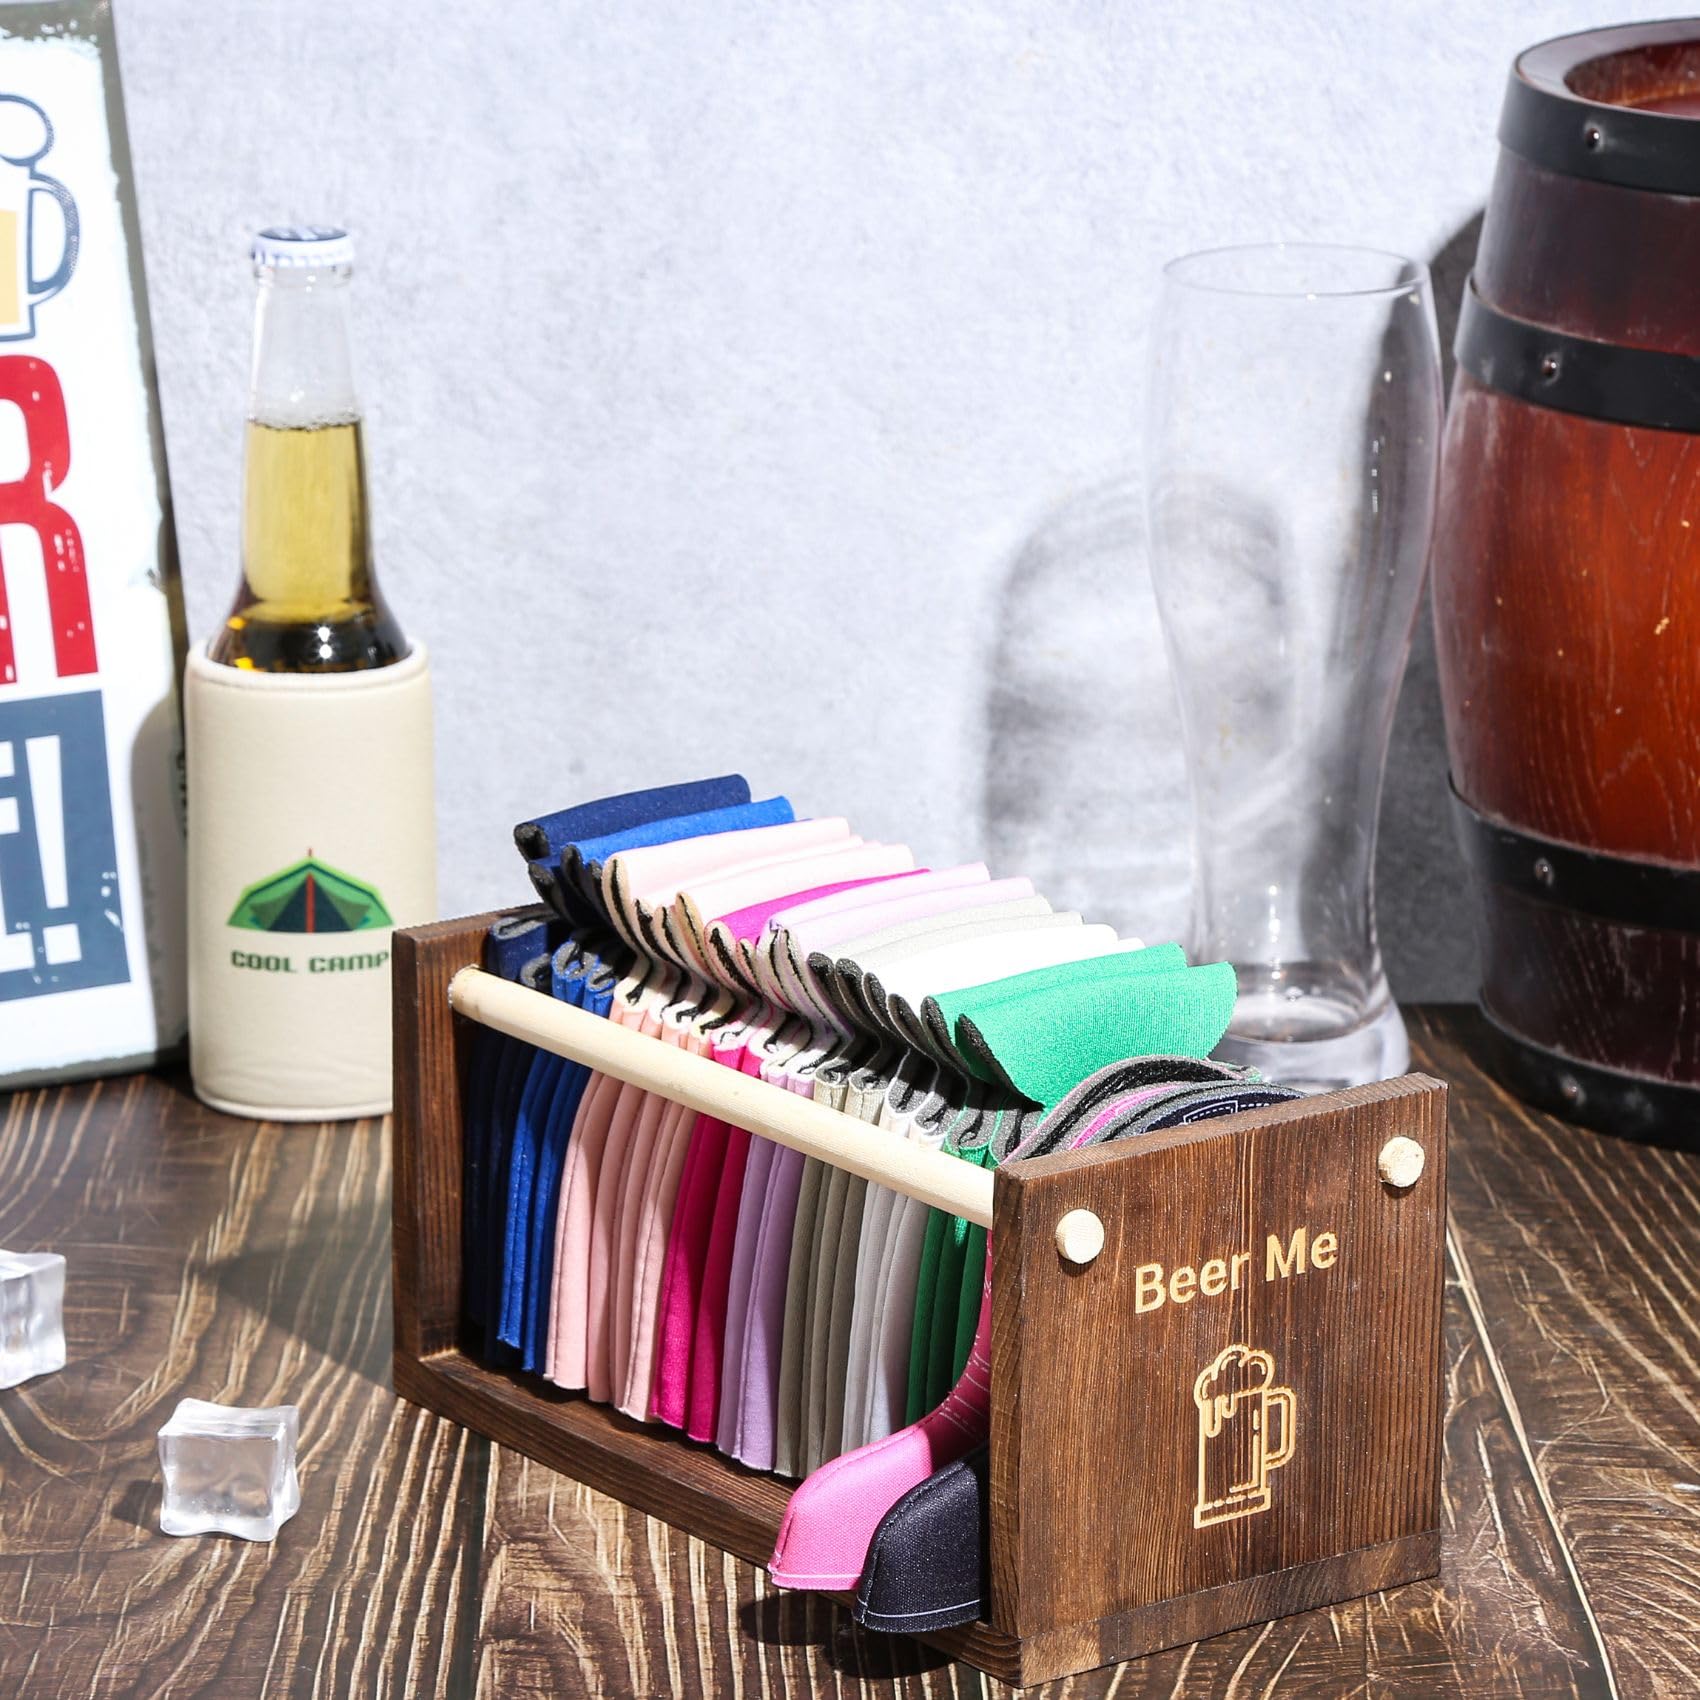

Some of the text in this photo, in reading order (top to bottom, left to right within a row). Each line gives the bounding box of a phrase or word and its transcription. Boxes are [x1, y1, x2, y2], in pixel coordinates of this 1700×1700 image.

[231, 950, 390, 974] COOL CAMP
[1134, 1226, 1338, 1314] Beer Me
